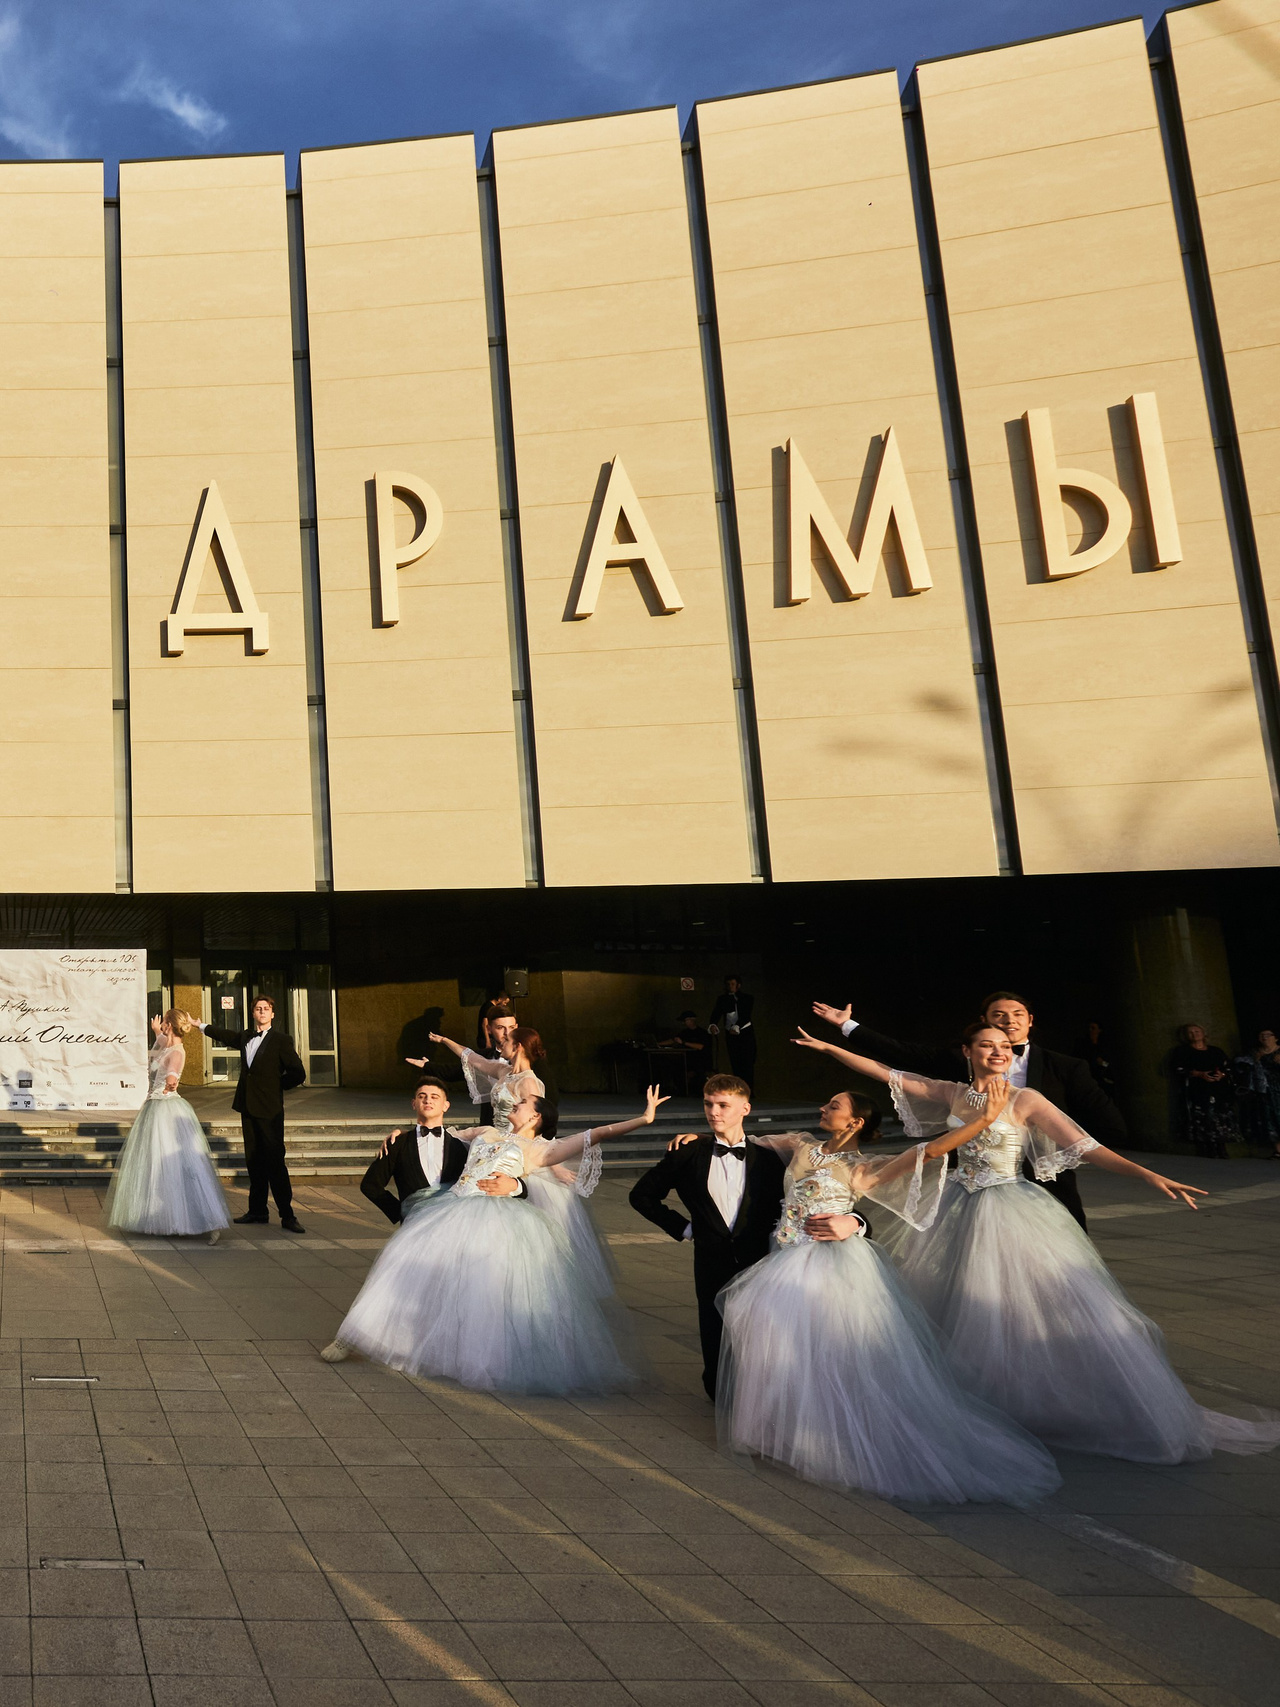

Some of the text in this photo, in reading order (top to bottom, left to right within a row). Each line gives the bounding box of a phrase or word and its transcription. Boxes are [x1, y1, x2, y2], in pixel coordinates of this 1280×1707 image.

[161, 391, 1183, 656] ДРАМЫ
[11, 1000, 71, 1022] Пушкин
[36, 1024, 130, 1044] Онегин
